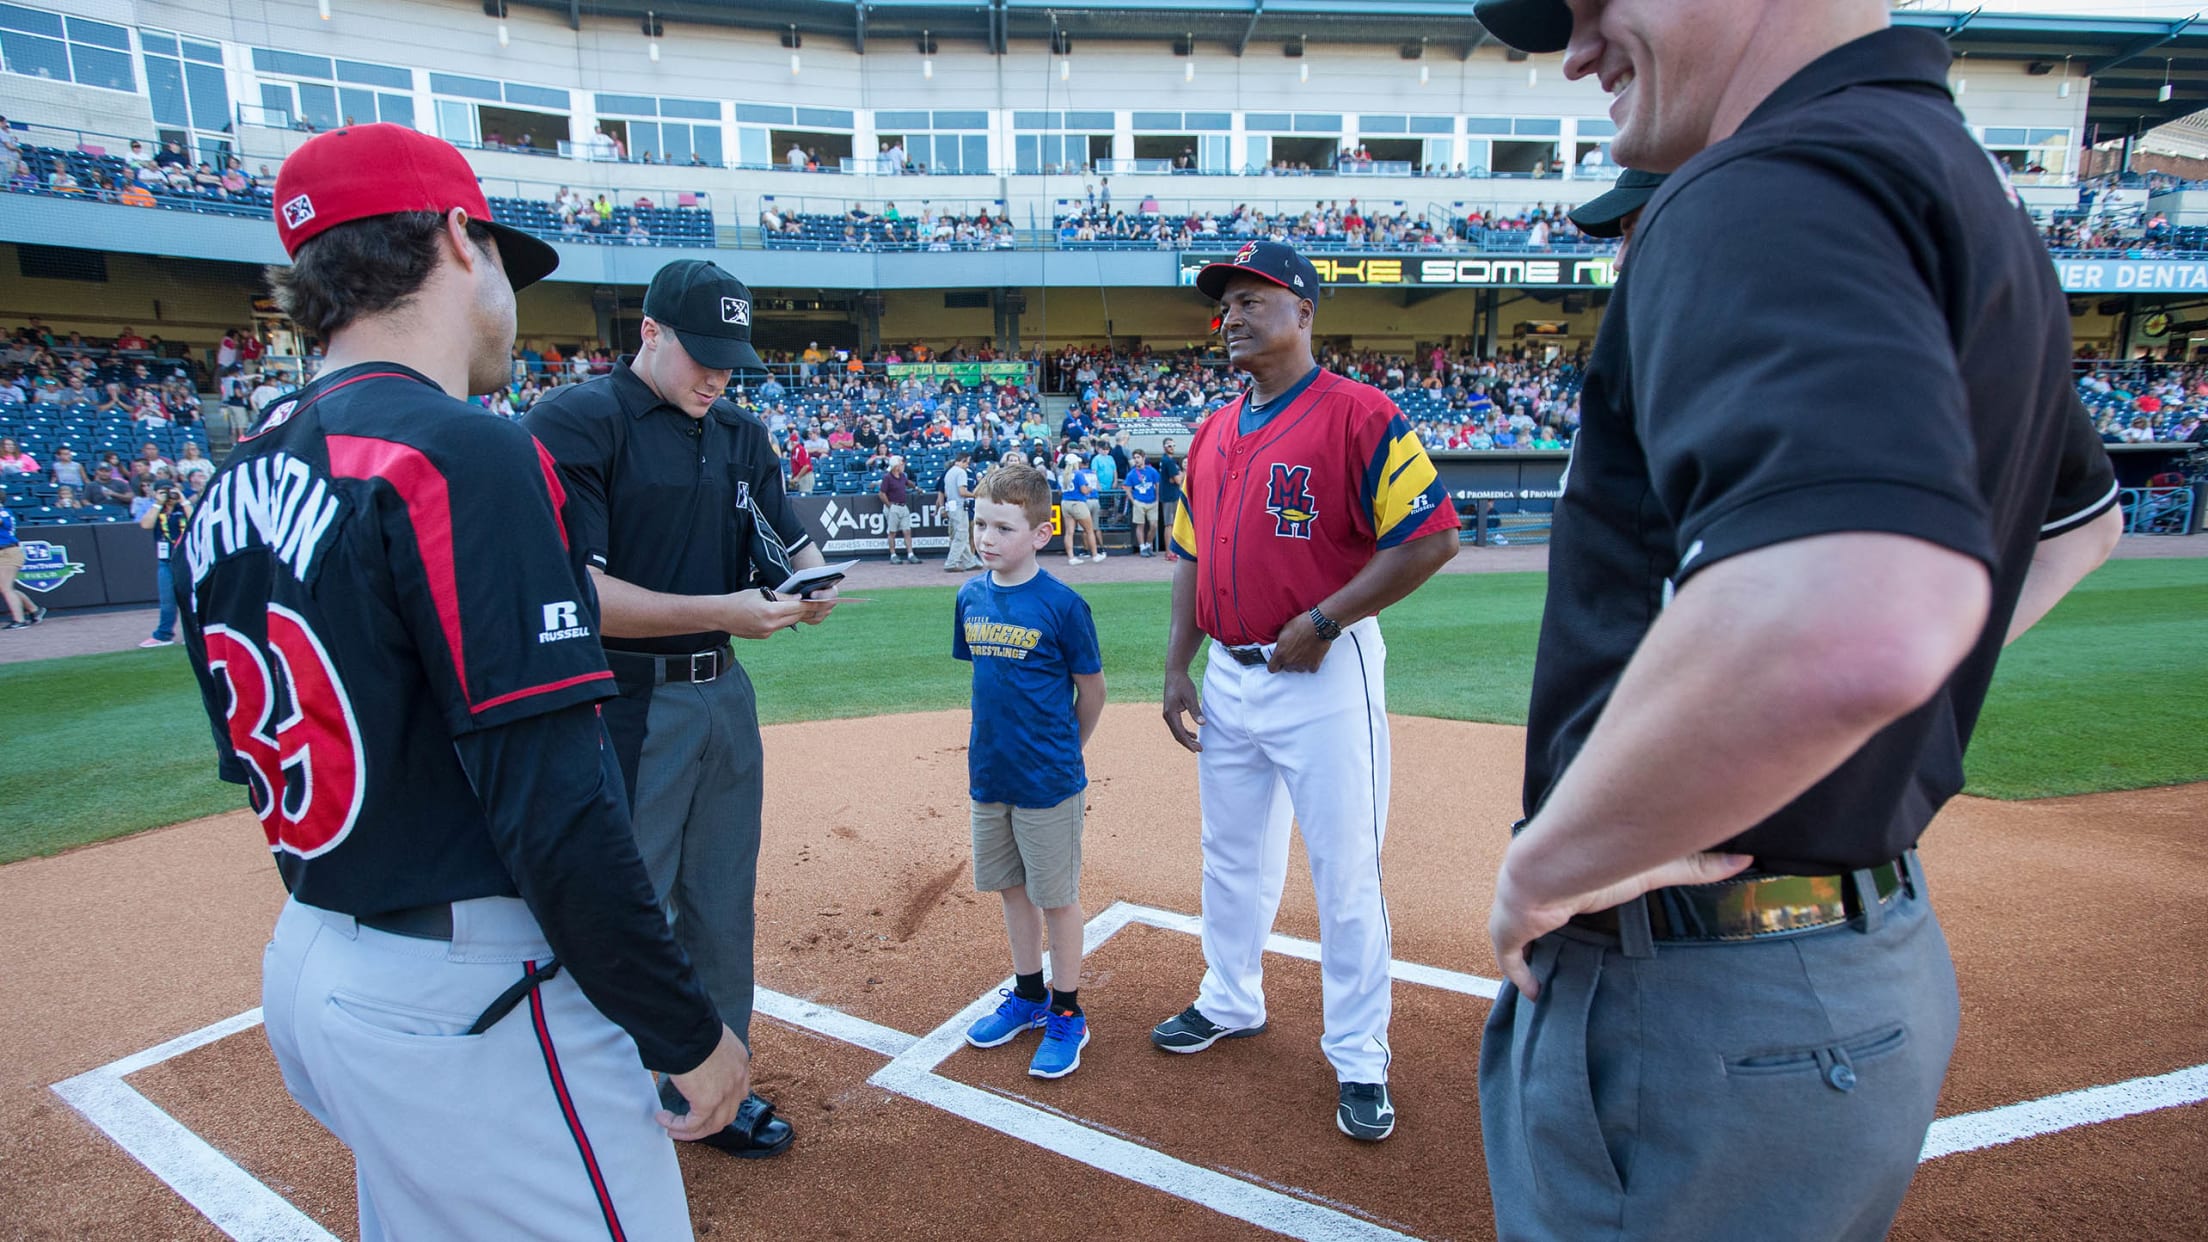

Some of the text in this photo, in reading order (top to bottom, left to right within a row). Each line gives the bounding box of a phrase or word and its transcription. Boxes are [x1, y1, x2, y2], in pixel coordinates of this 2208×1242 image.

[1421, 260, 1560, 284] SOME
[1572, 260, 1618, 284] N
[1466, 490, 1514, 499] PROMEDICA
[538, 627, 590, 644] RUSSELL
